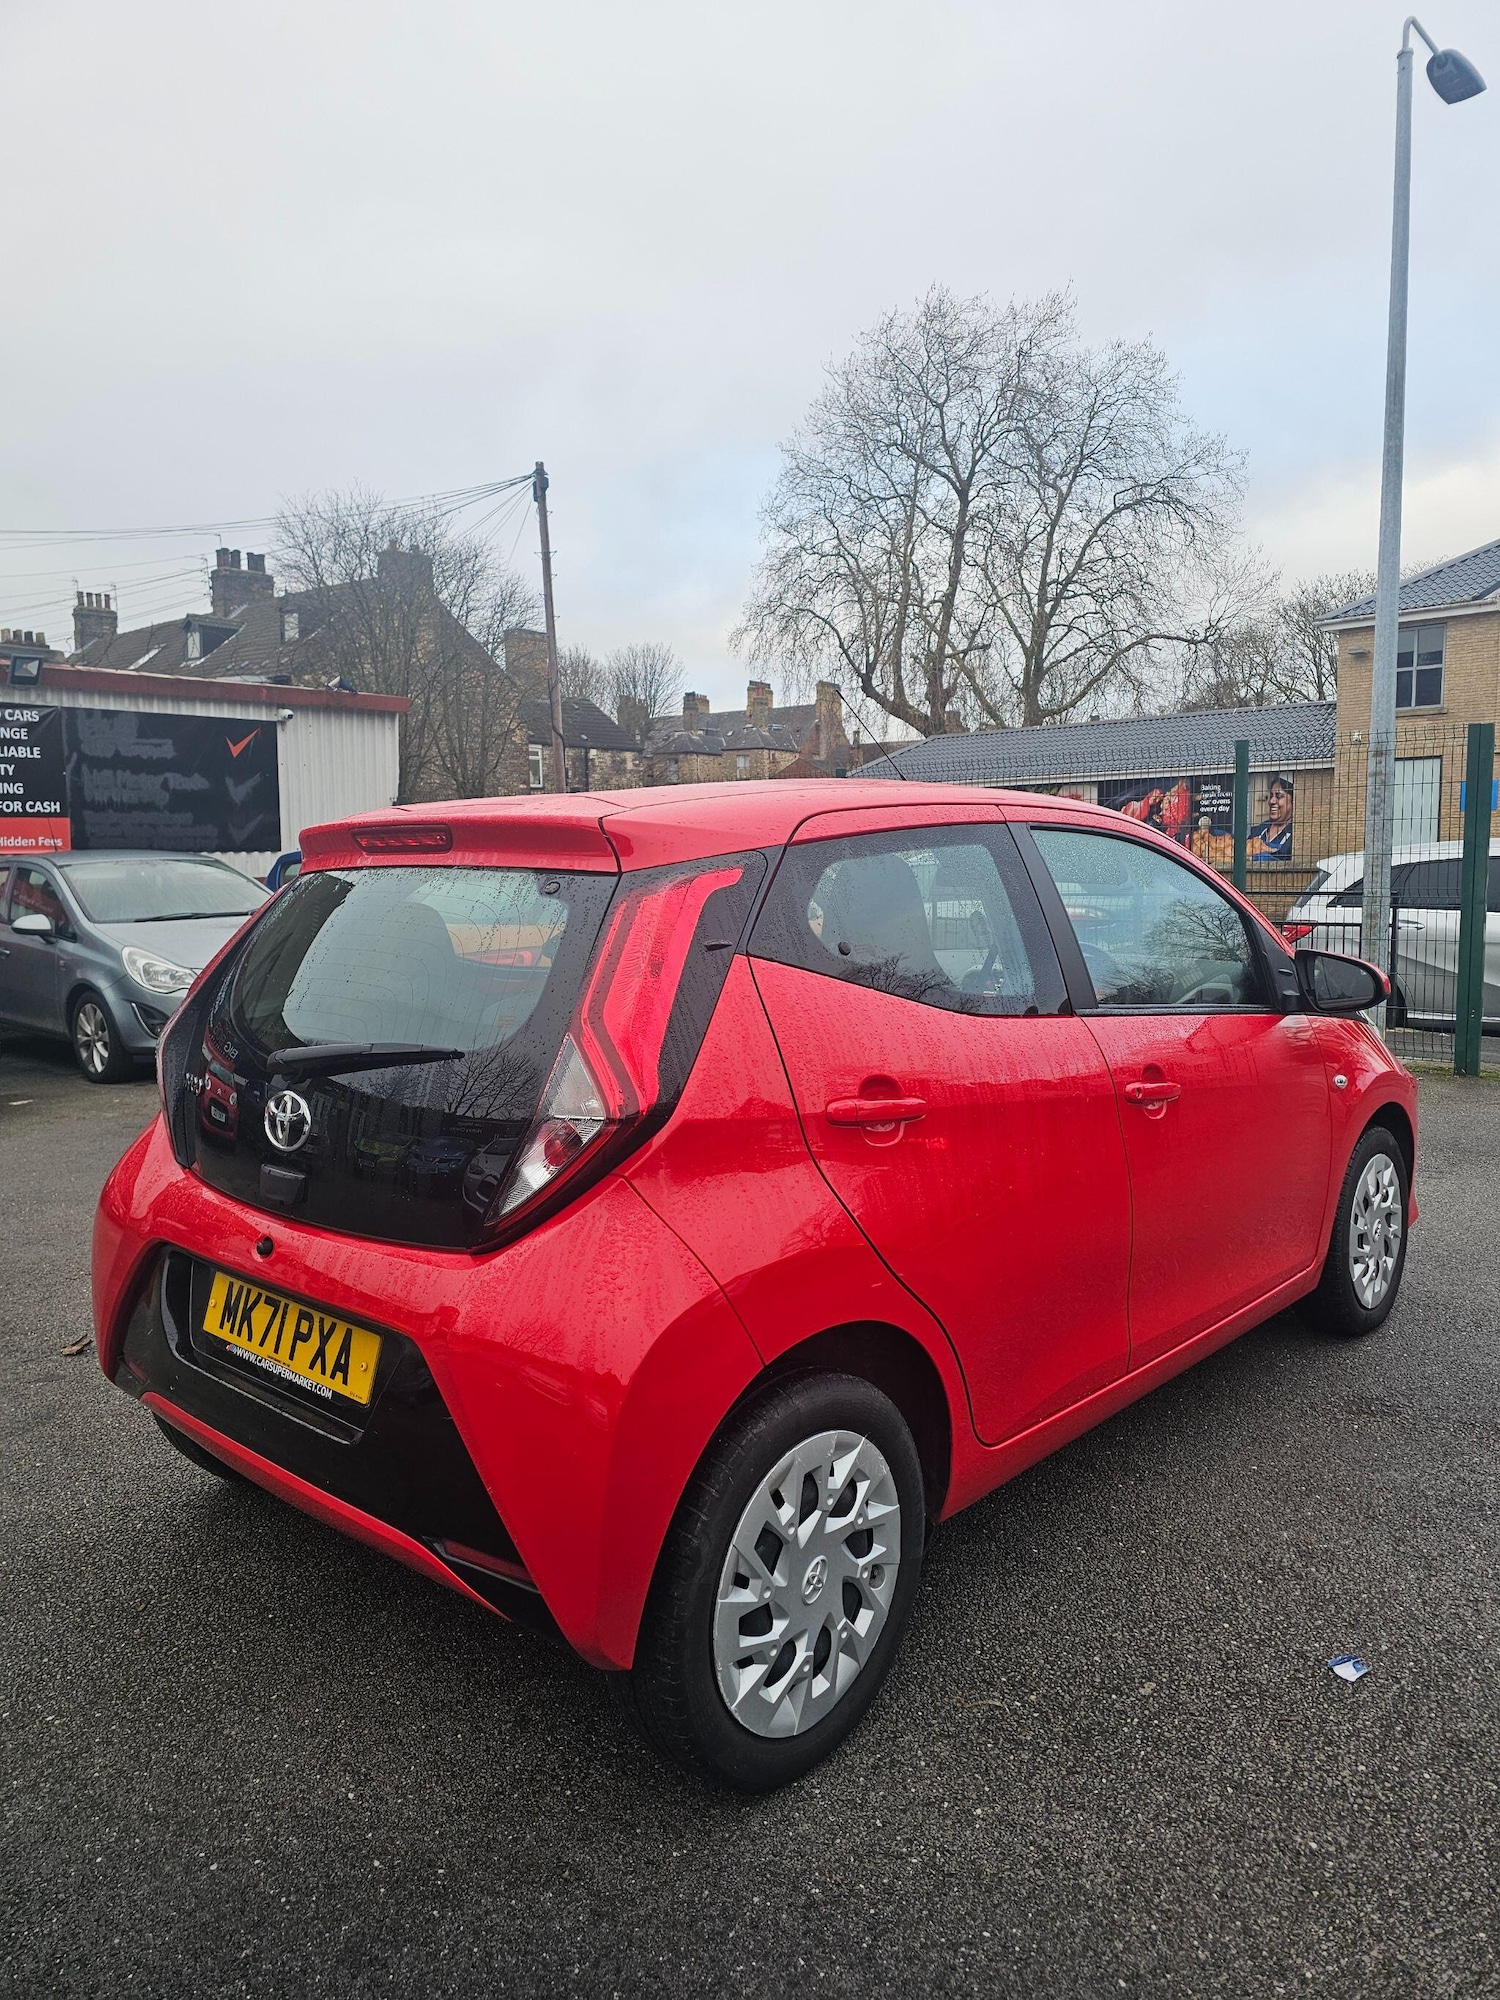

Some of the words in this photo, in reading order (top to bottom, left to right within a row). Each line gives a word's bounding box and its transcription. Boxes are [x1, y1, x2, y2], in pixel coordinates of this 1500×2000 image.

[4, 709, 40, 722] CARS
[0, 727, 29, 740] NGE
[0, 782, 24, 795] ING
[25, 801, 61, 814] CASH
[38, 836, 63, 847] Fees
[219, 1281, 290, 1355] MK71
[288, 1306, 353, 1386] PXA
[235, 1346, 333, 1400] WWW.CARSUPERMARKET.COM
